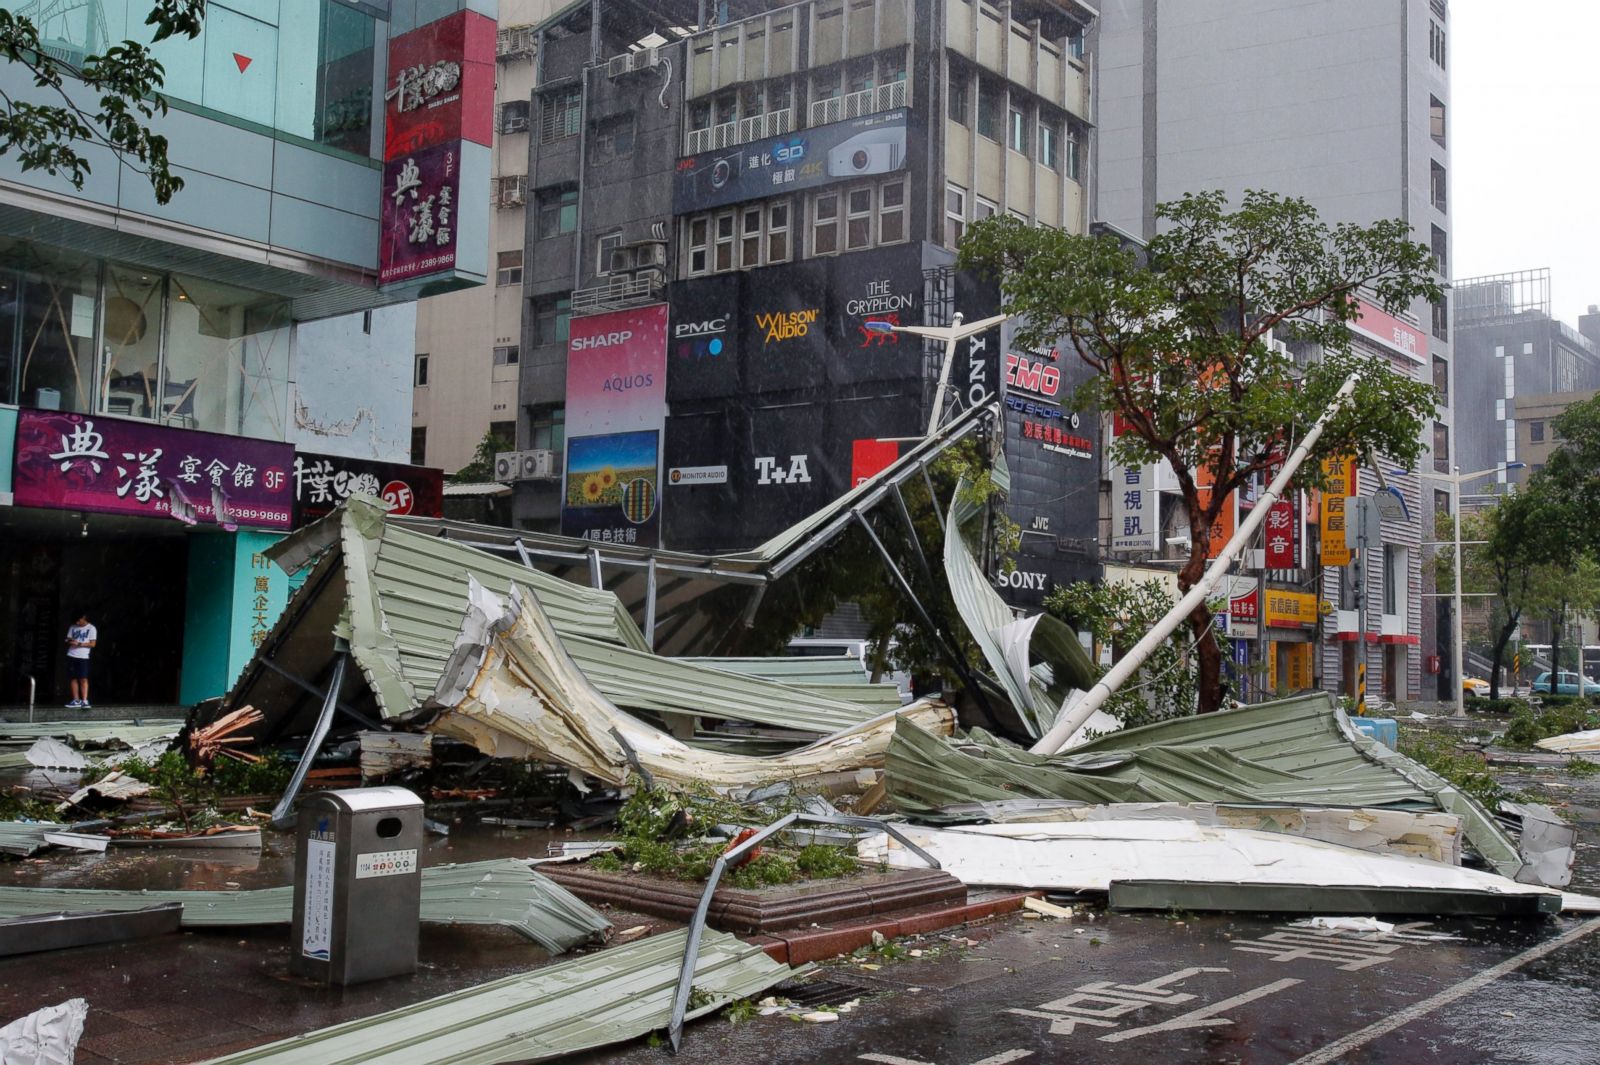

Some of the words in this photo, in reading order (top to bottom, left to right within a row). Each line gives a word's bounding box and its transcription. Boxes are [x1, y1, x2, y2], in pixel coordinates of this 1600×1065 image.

[777, 145, 803, 161] 3D
[869, 280, 891, 295] THE
[846, 293, 913, 316] GRYPHON
[675, 318, 727, 336] PMC
[756, 309, 817, 330] WILSON
[571, 330, 633, 352] SHARP
[765, 323, 808, 344] AUDIO
[603, 374, 653, 392] AQUOS
[1025, 402, 1063, 419] SHOP
[49, 421, 163, 501] 典漾
[177, 454, 257, 489] 宴會館
[265, 470, 285, 489] 3F
[755, 454, 812, 485] T+A
[682, 471, 707, 480] MONITOR
[708, 471, 725, 479] AUDIO
[384, 487, 411, 511] 2F
[1124, 468, 1143, 536] 音視訊
[1032, 516, 1050, 530] JVC
[582, 528, 637, 543] 4原色技術
[998, 569, 1048, 591] SONY
